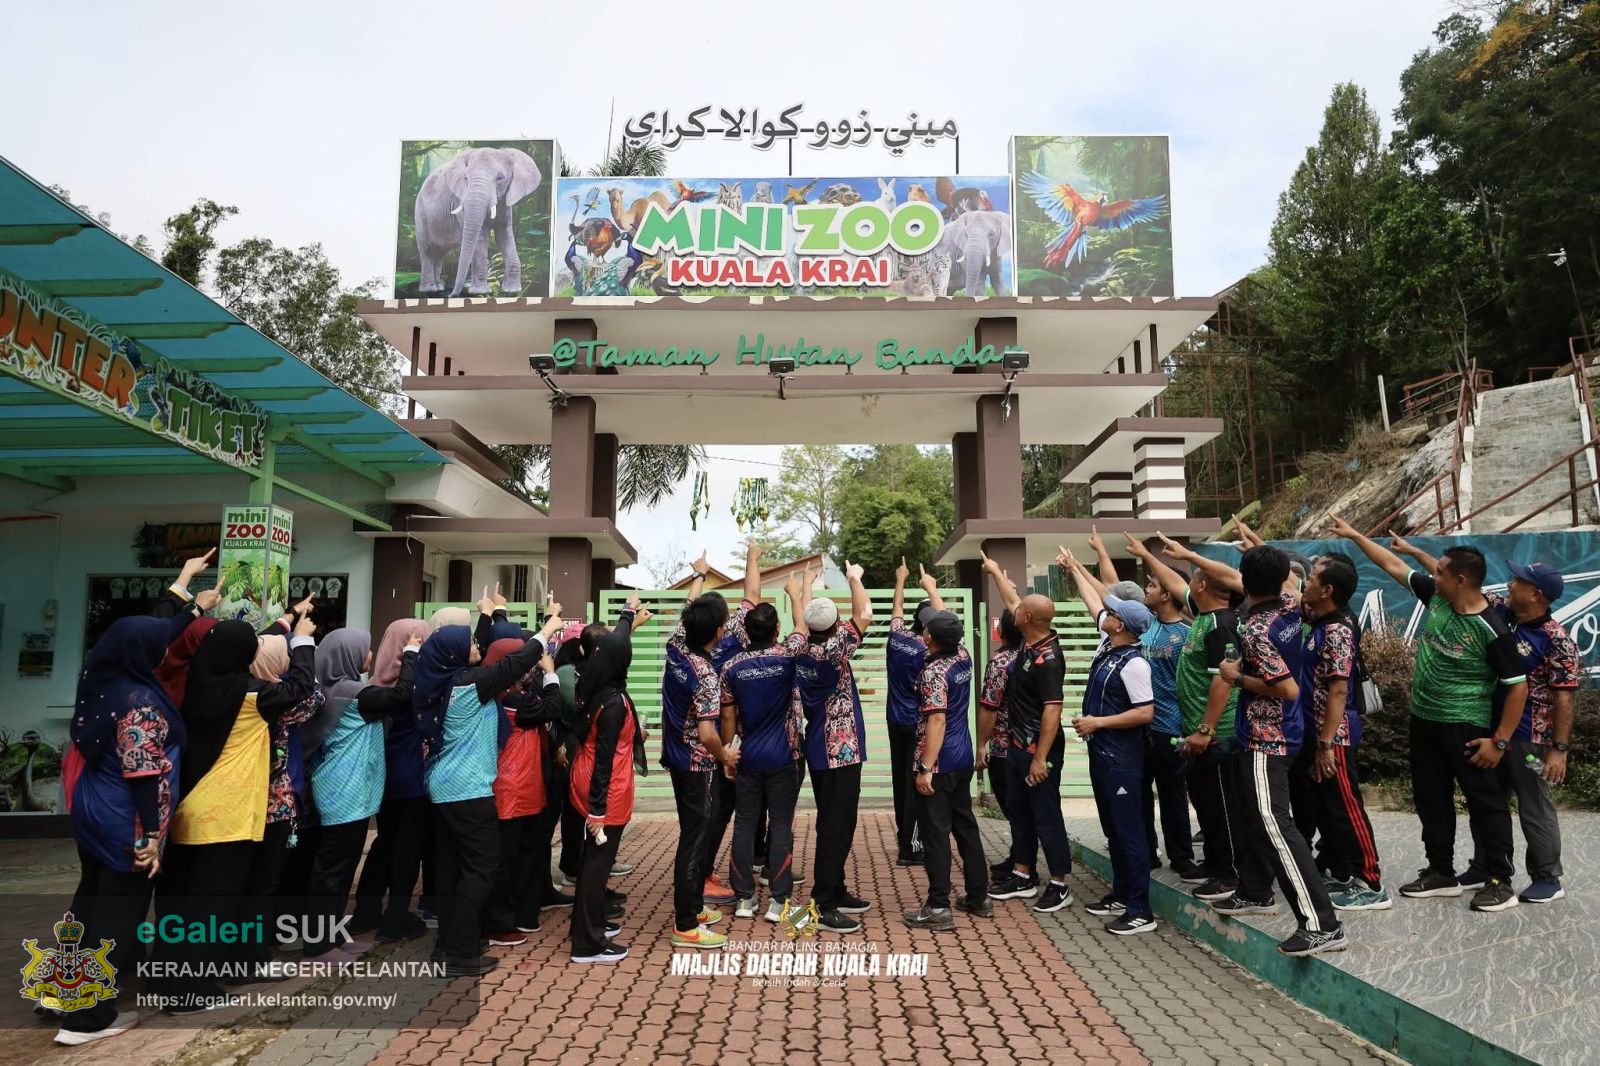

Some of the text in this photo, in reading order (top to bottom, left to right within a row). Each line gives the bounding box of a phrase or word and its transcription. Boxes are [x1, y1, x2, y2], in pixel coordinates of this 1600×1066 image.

[624, 104, 712, 149] كراي
[719, 102, 804, 149] كوالا
[883, 111, 959, 156] ميني
[634, 203, 941, 253] MINI ZOO
[670, 258, 889, 284] KUALA KRAI
[552, 336, 720, 368] @Taman
[167, 386, 259, 454] TIKET
[227, 508, 267, 523] mini
[273, 513, 291, 530] mini
